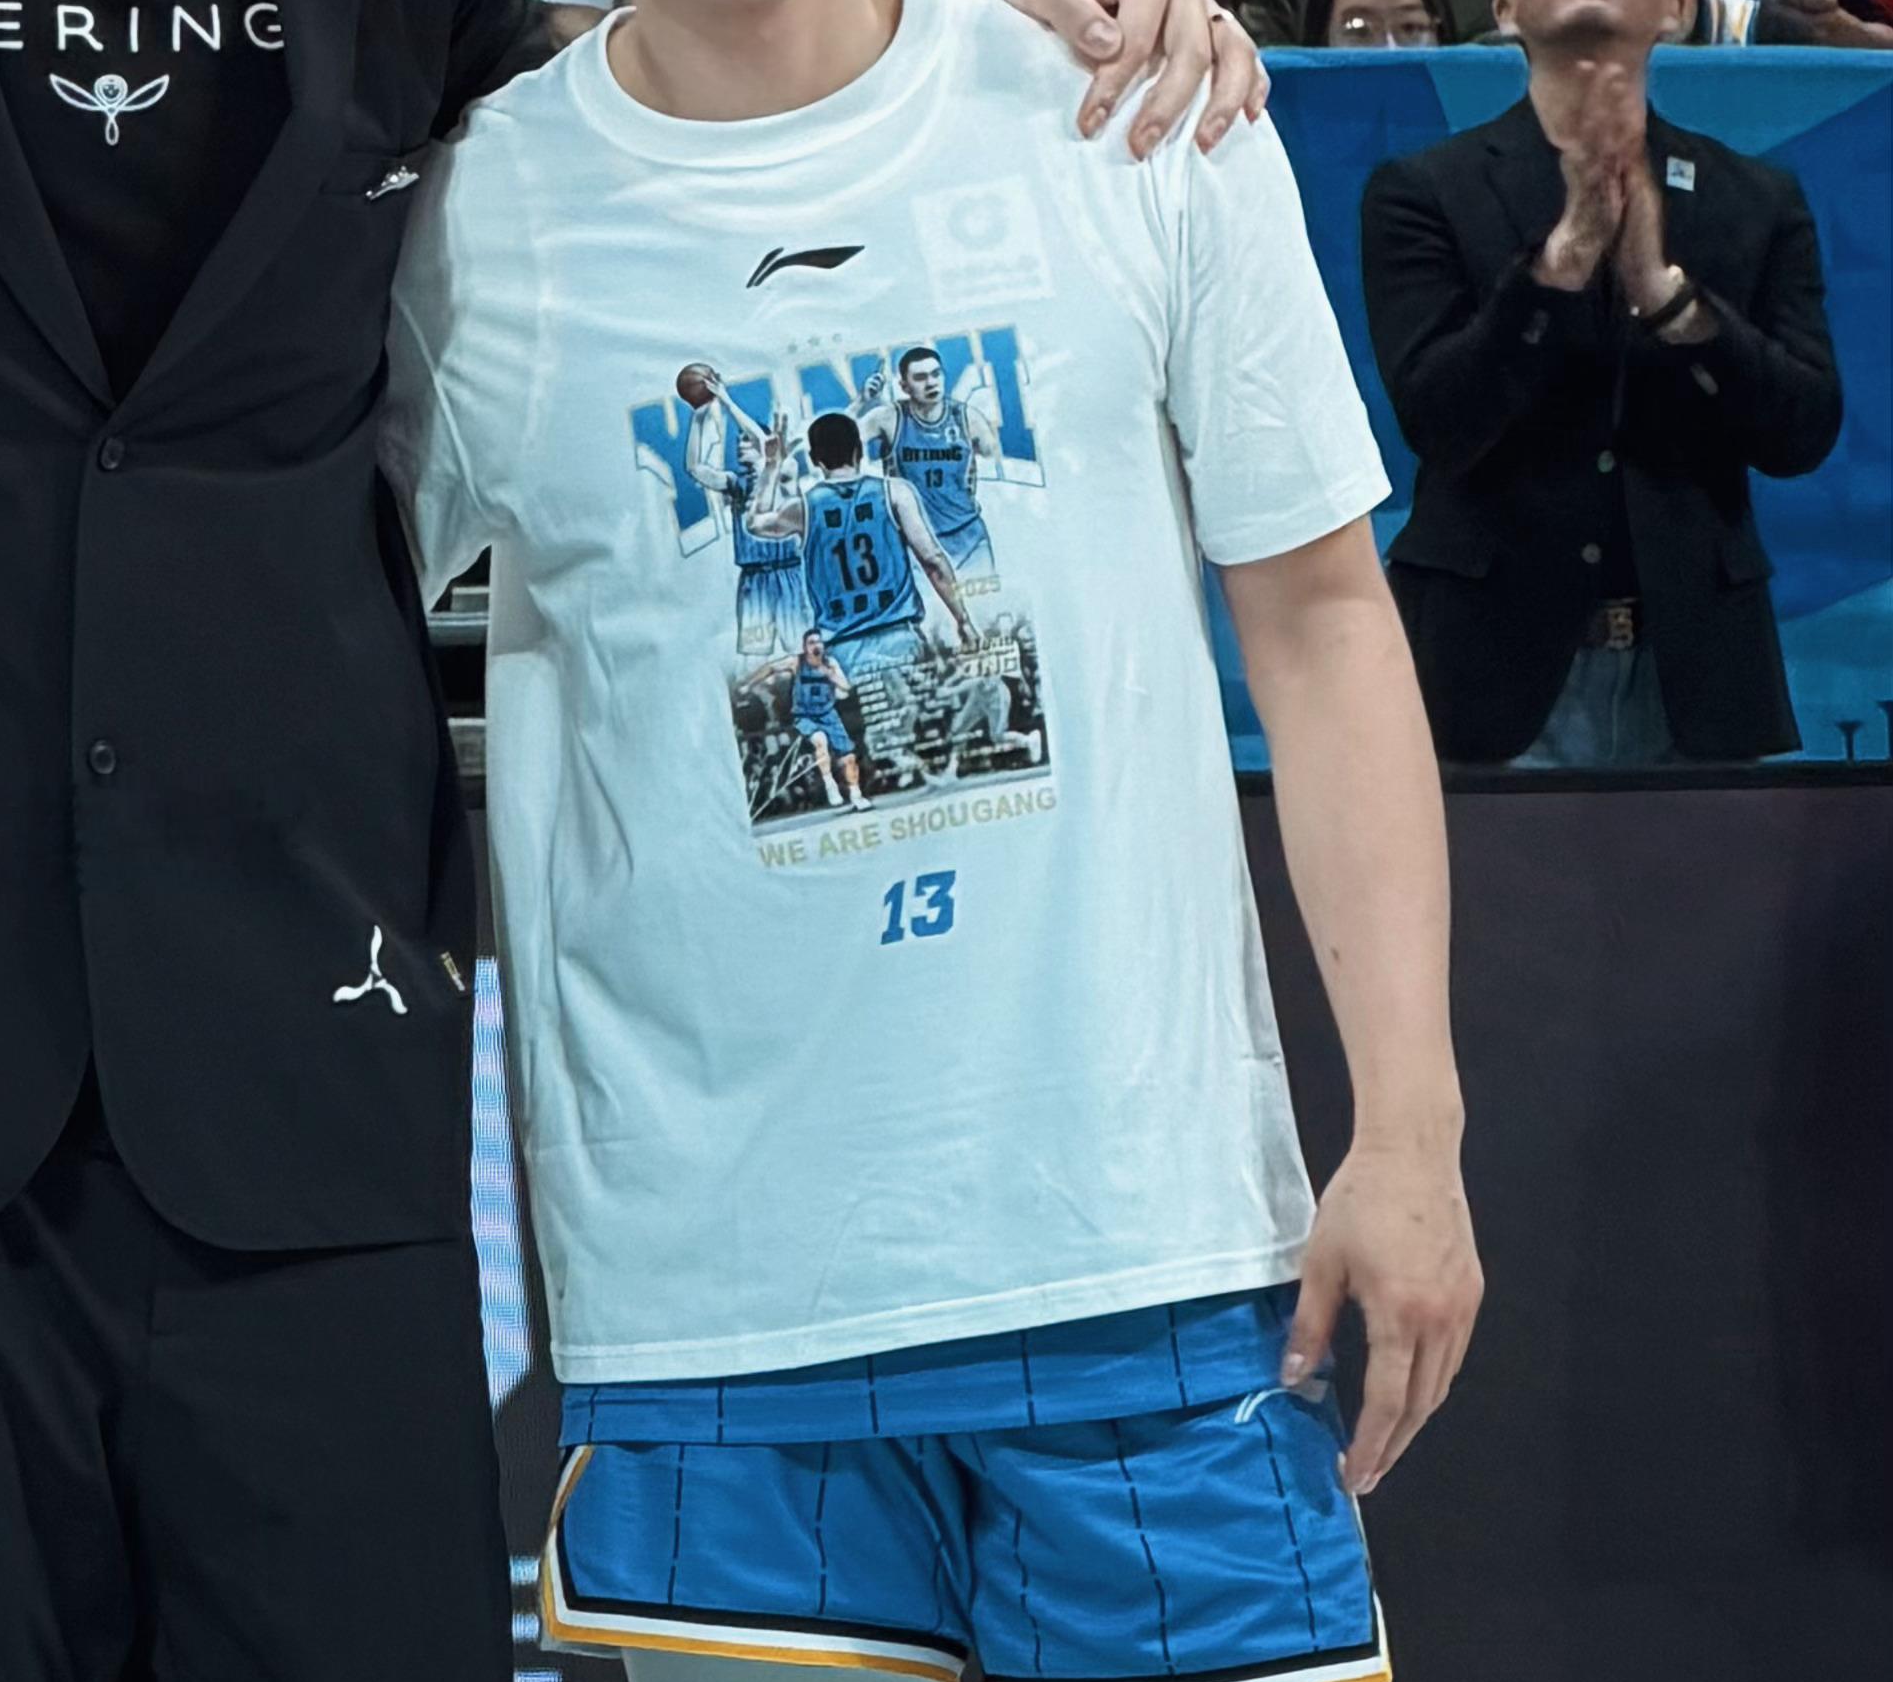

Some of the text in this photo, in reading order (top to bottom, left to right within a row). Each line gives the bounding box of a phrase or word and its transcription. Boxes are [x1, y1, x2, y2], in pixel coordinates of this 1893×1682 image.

[923, 467, 944, 489] 13
[831, 531, 880, 591] 13
[759, 786, 1057, 869] WE ARE SHOUGANG
[880, 869, 957, 946] 13
